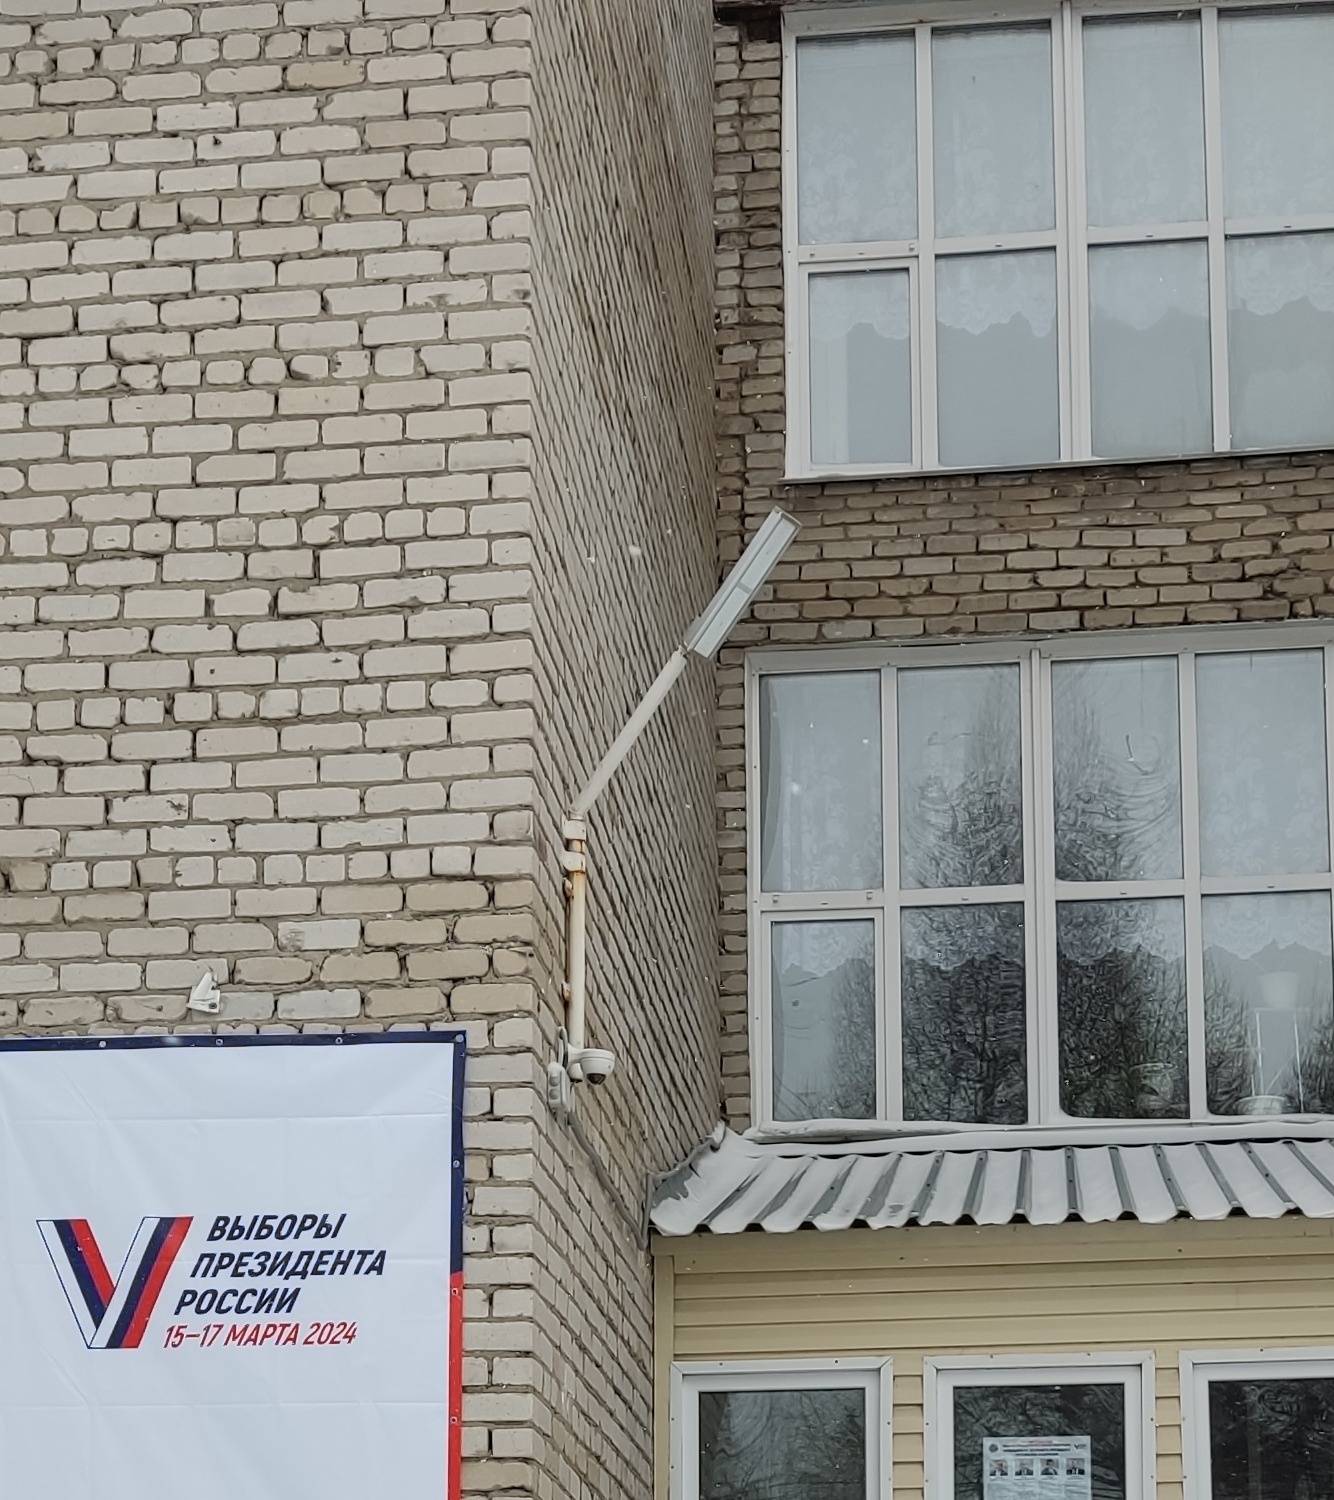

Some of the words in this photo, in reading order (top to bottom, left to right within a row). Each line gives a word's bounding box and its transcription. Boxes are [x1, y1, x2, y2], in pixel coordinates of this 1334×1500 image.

[206, 1213, 347, 1241] ВЫБОРЫ
[190, 1250, 386, 1280] ПРЕЗИДЕНТА
[174, 1288, 301, 1315] РОССИИ
[224, 1323, 299, 1347] МАРТА
[302, 1321, 357, 1346] 2024
